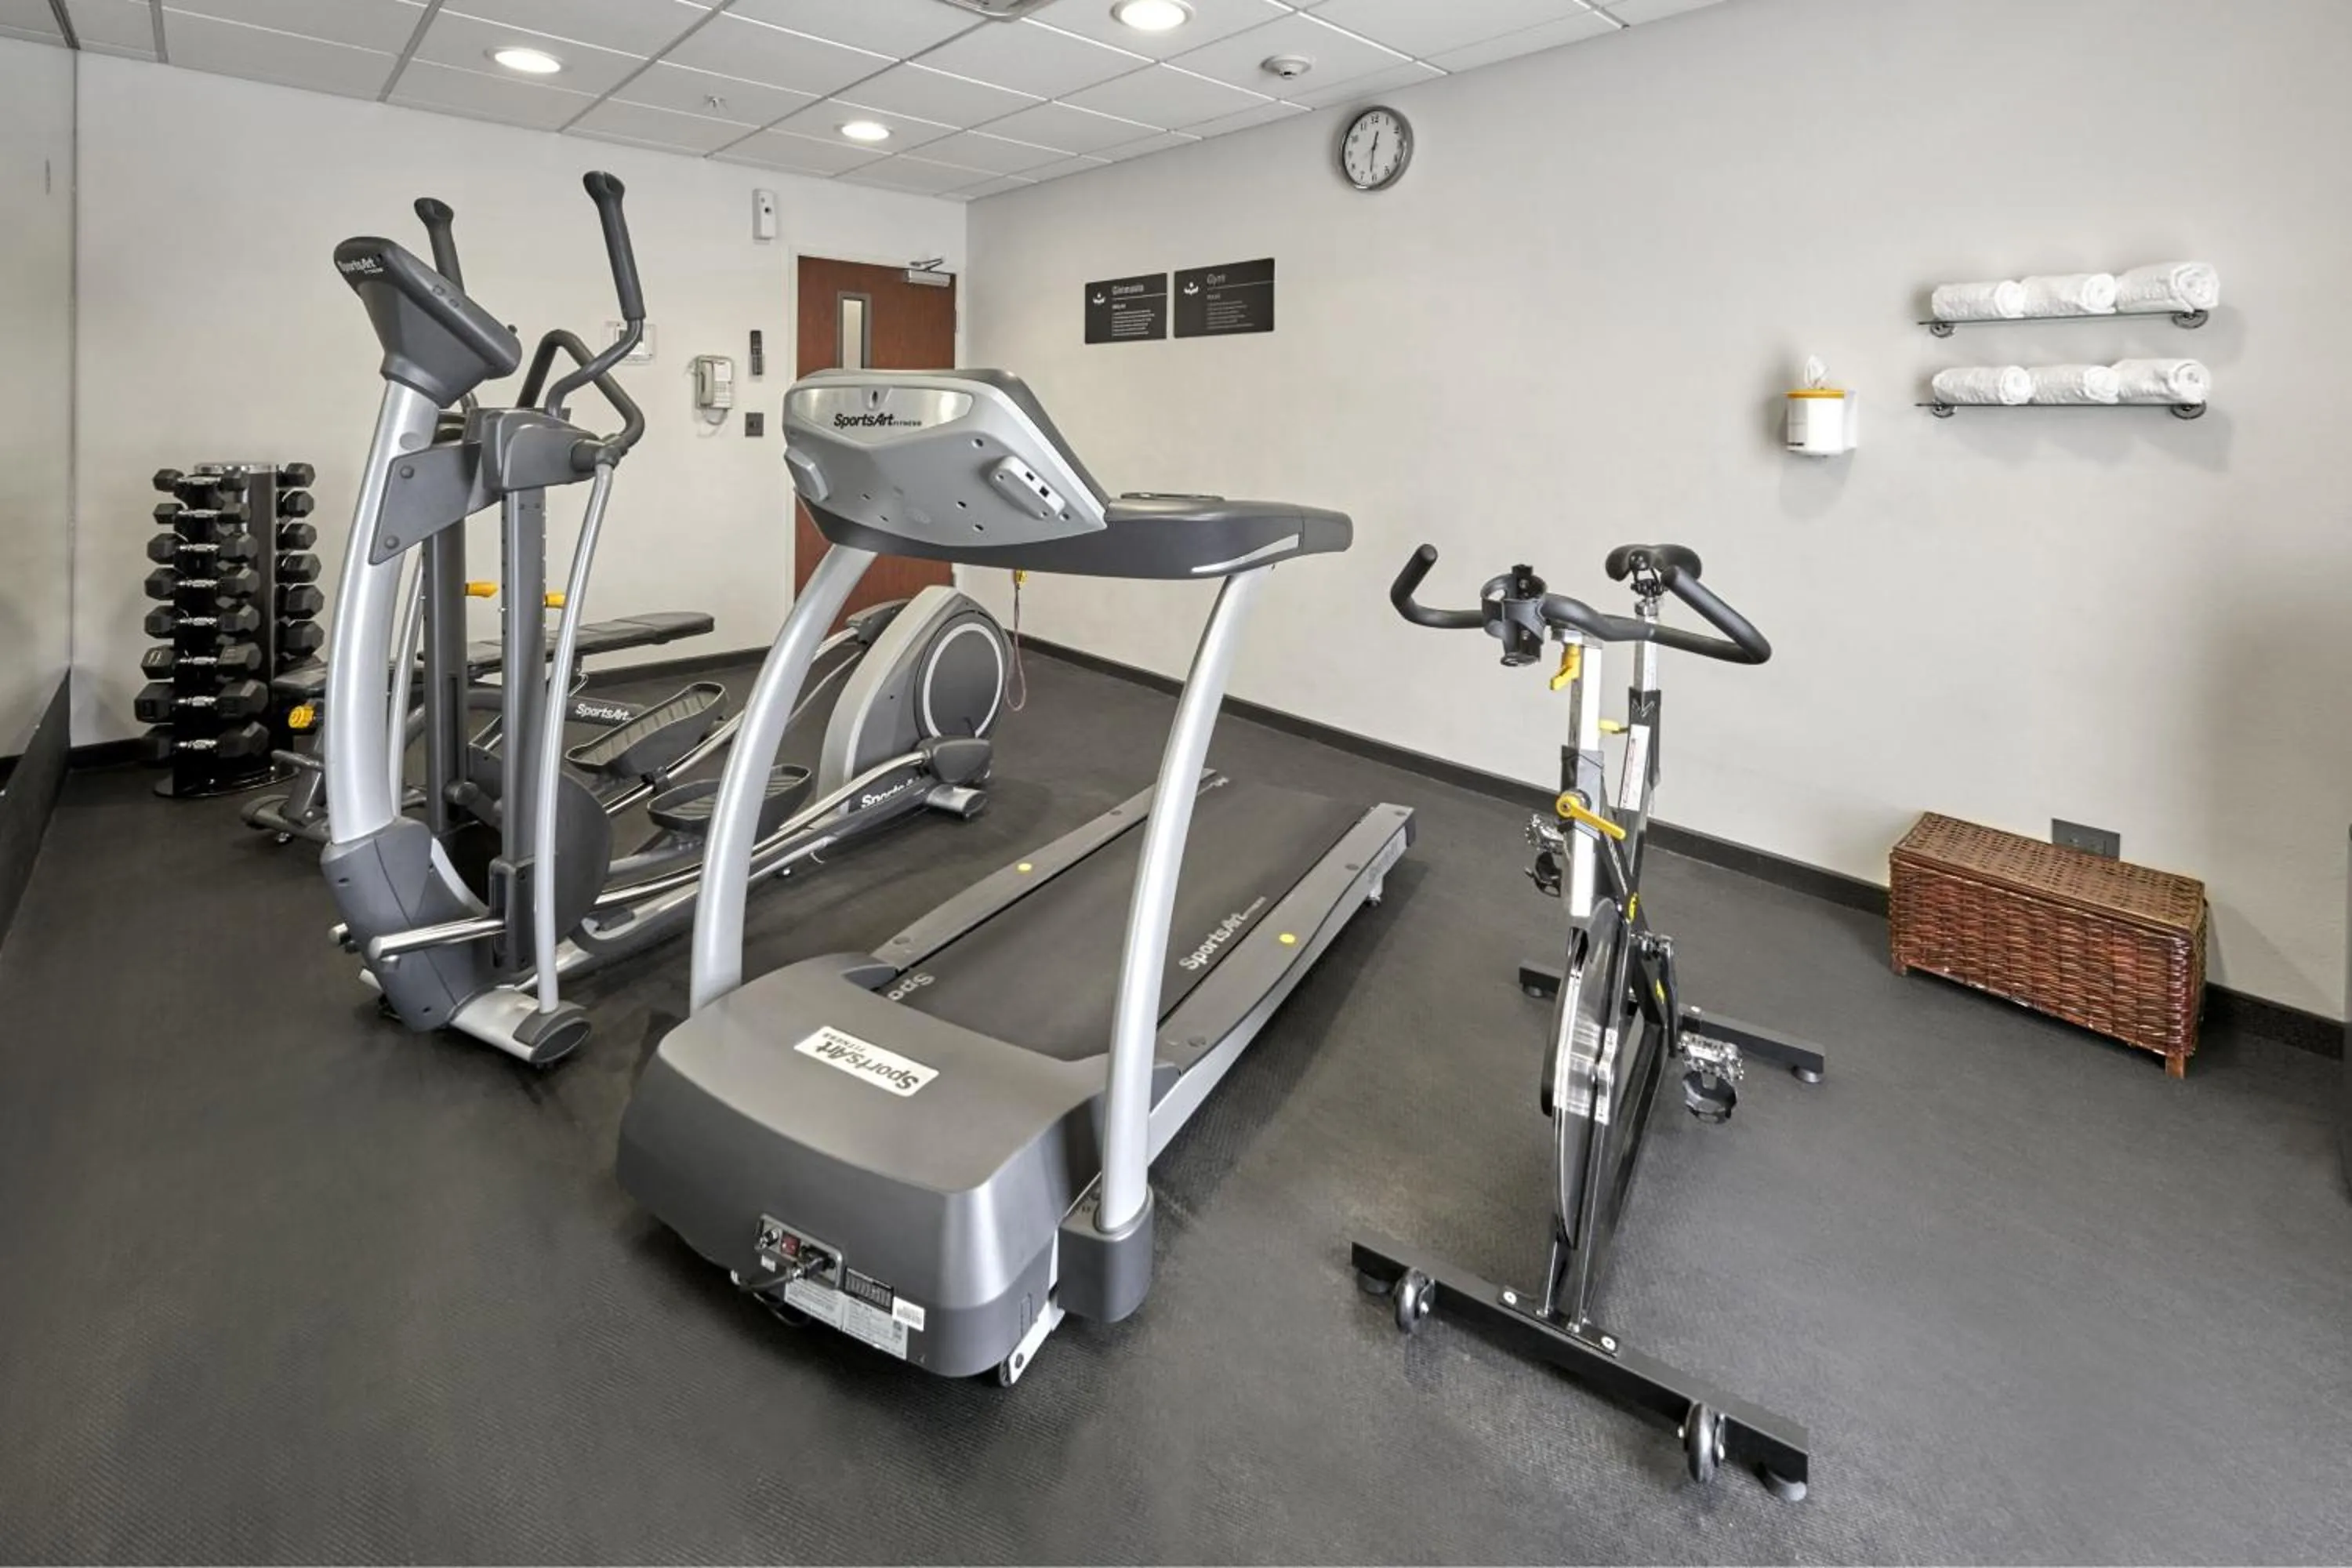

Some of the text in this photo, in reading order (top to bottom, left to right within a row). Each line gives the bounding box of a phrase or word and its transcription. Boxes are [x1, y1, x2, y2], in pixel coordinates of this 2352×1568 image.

[833, 413, 895, 430] SportsArt
[575, 702, 630, 720] SportsArt
[1178, 913, 1245, 970] SportsArt
[815, 1040, 920, 1090] SportsArt
